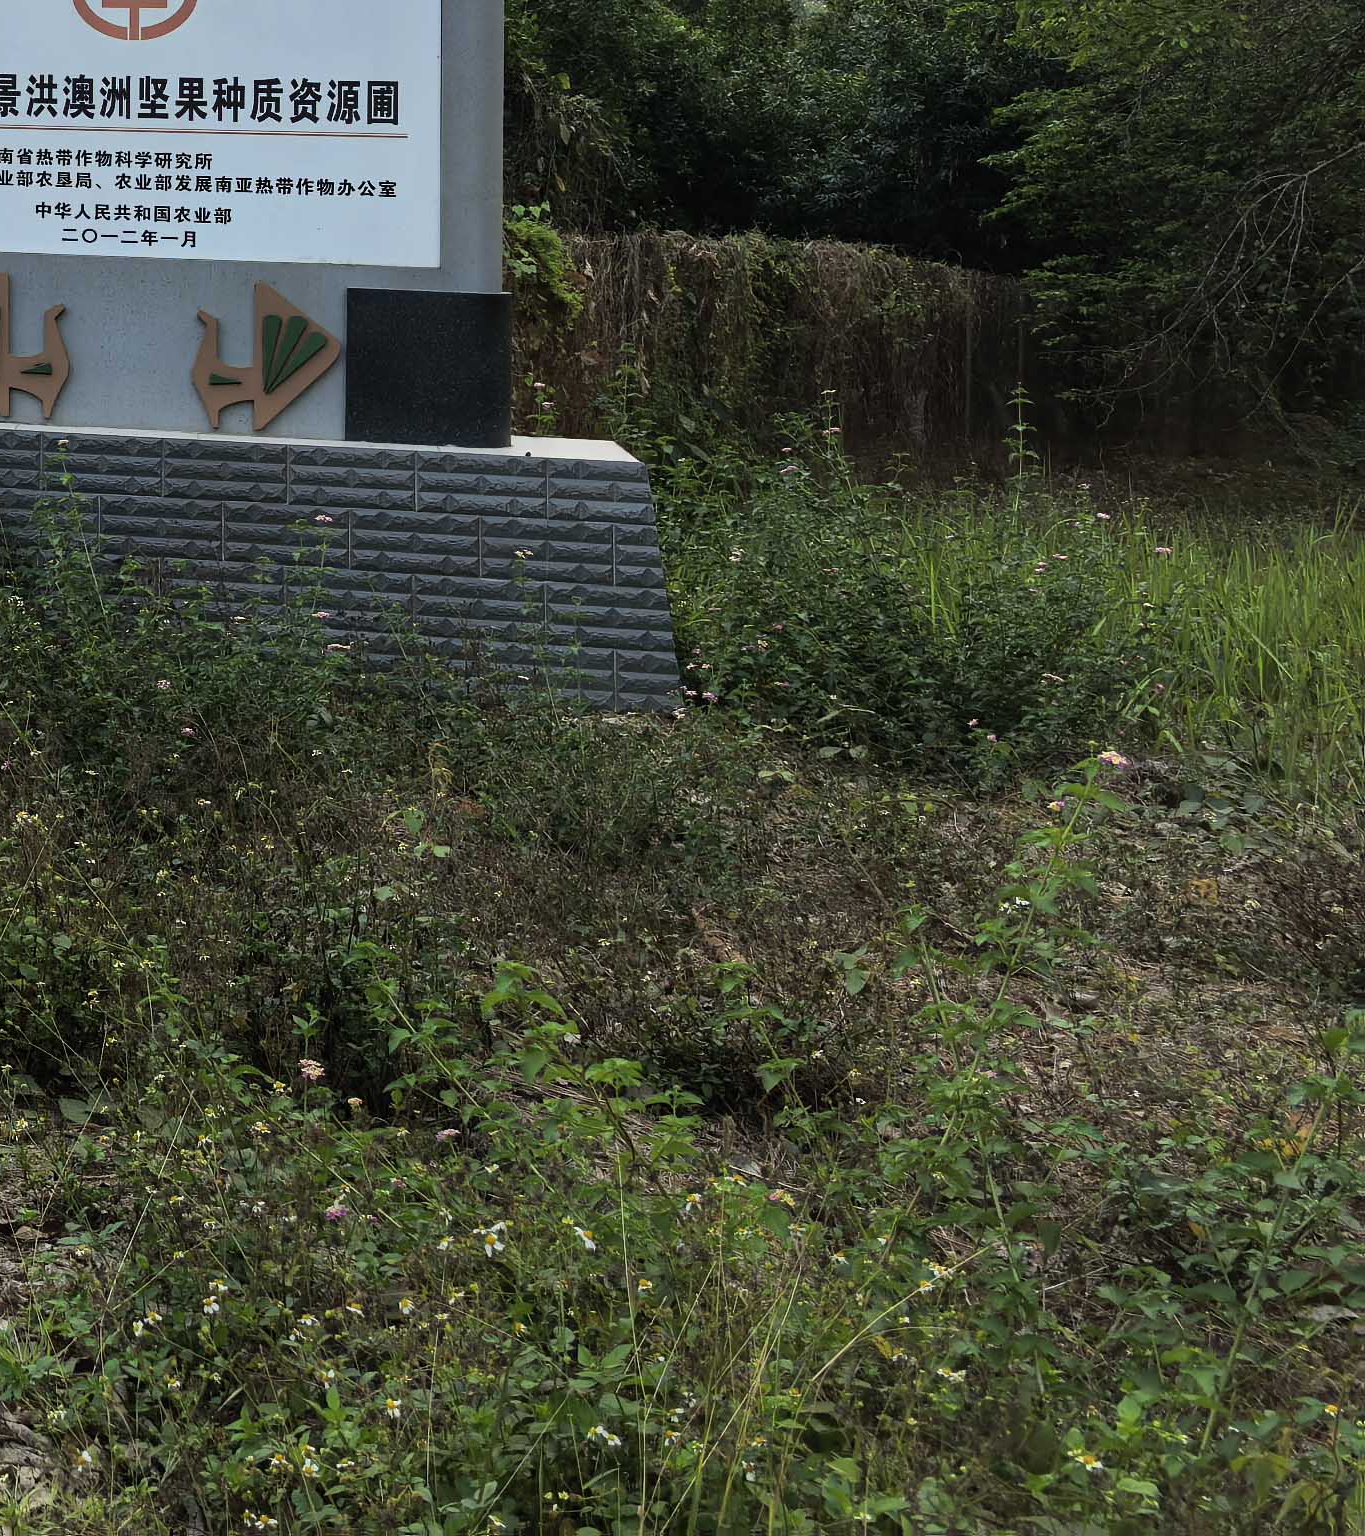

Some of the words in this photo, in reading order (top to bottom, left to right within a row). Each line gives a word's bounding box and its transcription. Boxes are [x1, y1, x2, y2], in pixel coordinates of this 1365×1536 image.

[35, 201, 232, 225] 中华人民共和国农业部
